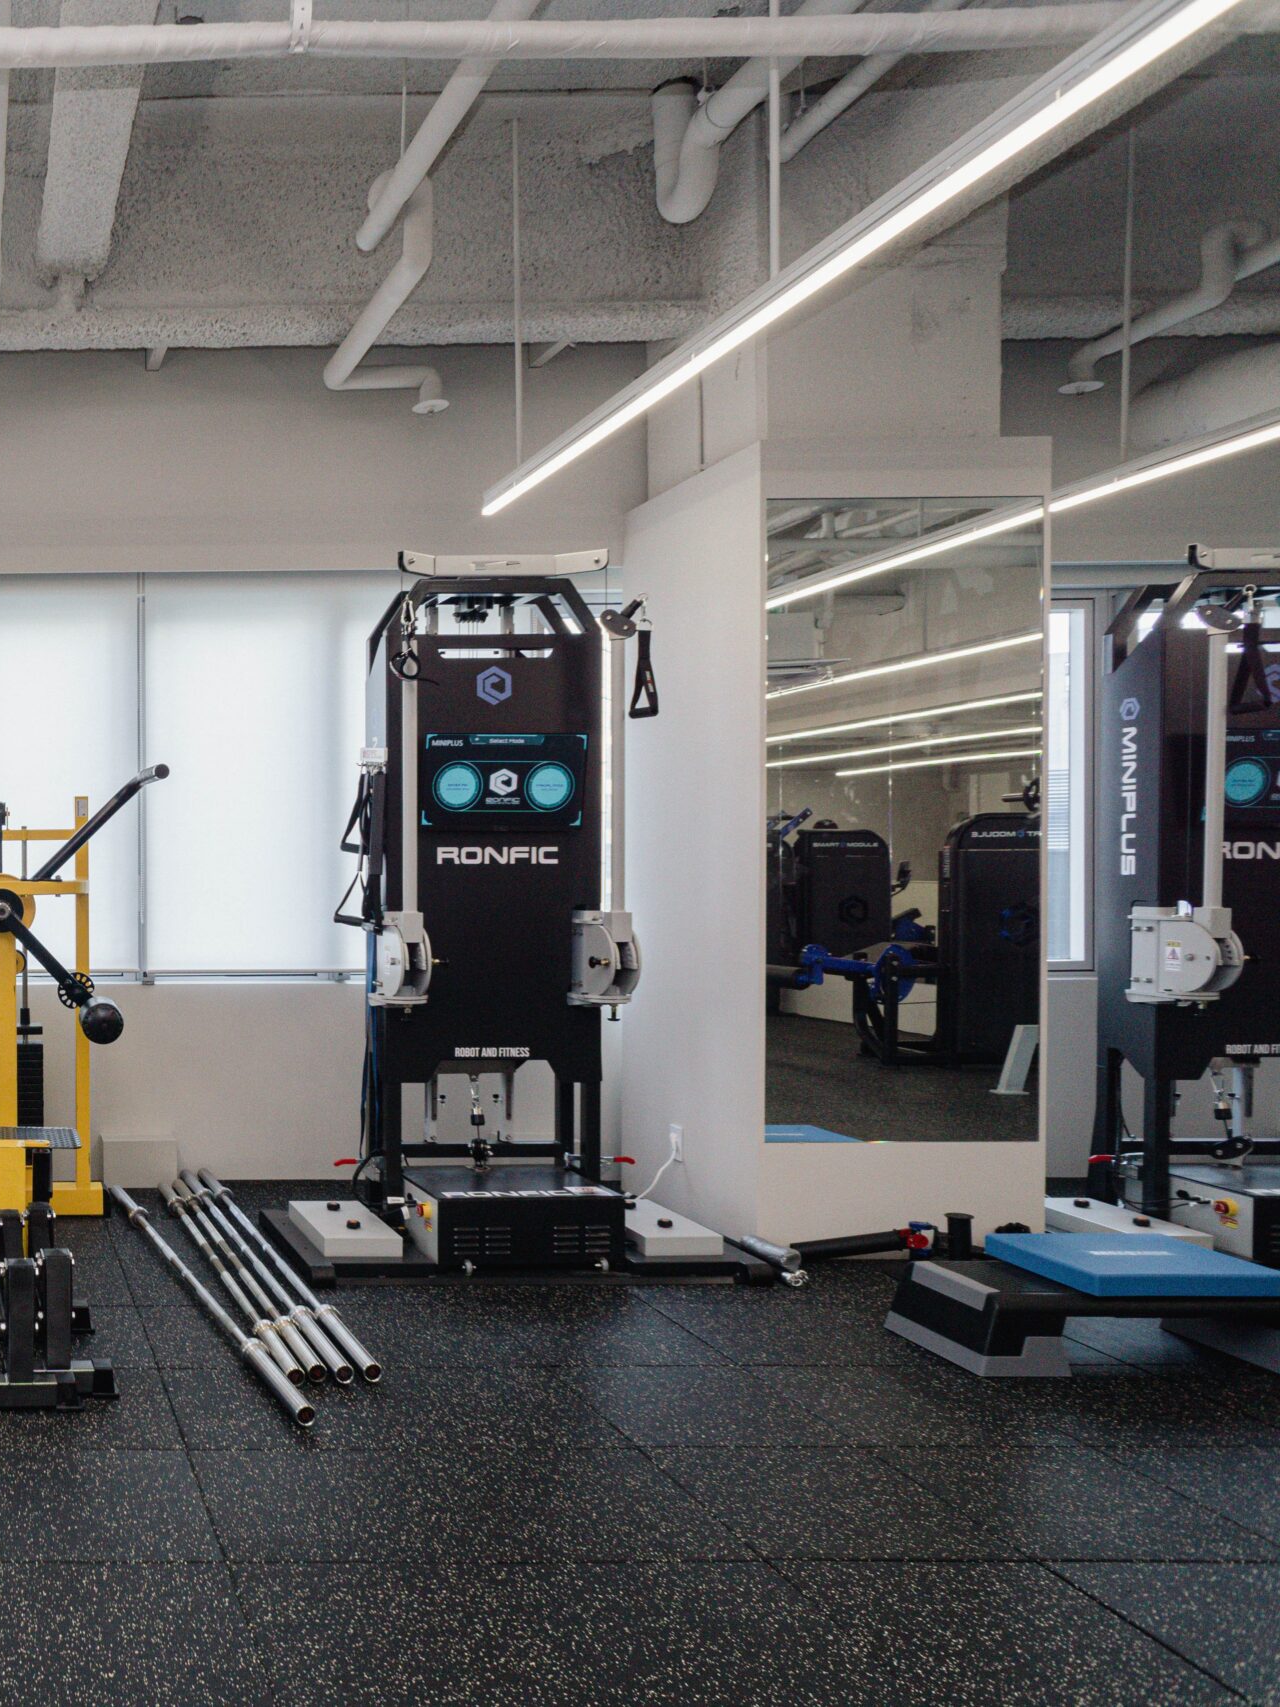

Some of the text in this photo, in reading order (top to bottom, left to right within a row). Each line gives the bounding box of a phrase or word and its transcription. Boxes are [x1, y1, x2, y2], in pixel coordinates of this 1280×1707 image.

[431, 739, 464, 747] MINIPLUS
[1120, 726, 1138, 876] MINIPLUS
[436, 846, 559, 865] RONFIC
[454, 1047, 530, 1058] ROBOT AND FITNESS
[1225, 1044, 1252, 1055] ROBOT
[1253, 1044, 1270, 1055] AND
